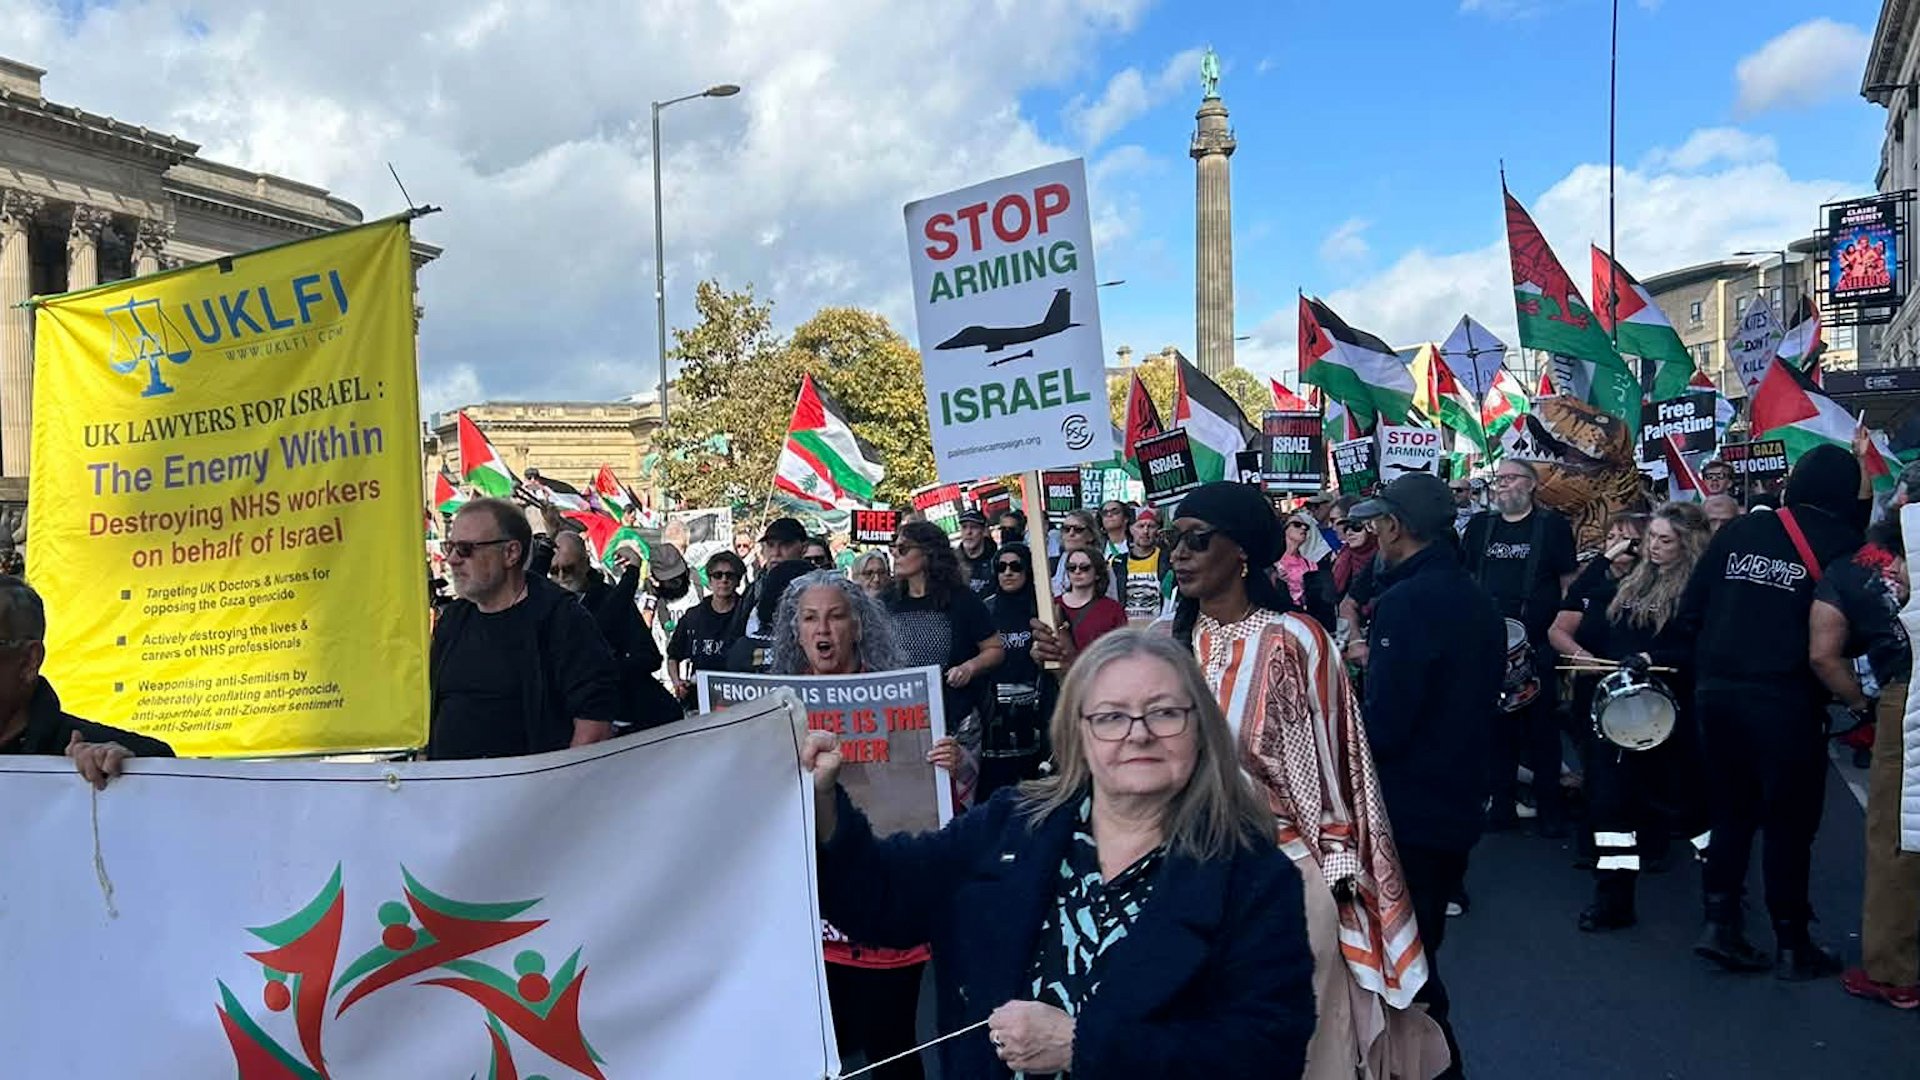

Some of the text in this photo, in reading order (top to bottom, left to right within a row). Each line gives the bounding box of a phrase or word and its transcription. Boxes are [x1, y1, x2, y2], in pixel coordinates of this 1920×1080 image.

[924, 183, 1071, 261] STOP
[929, 240, 1078, 304] ARMING
[183, 269, 349, 345] UKLFI
[939, 367, 1091, 426] ISRAEL
[84, 423, 120, 448] UK
[126, 406, 236, 444] LAWYERS
[241, 399, 285, 428] FOR
[290, 376, 370, 416] ISRAEL
[1657, 401, 1695, 421] Free
[1388, 431, 1437, 446] STOP
[1643, 415, 1714, 441] Palestine
[947, 435, 1041, 459] palestinecampaign.org
[1272, 436, 1312, 454] ISRAEL
[1386, 446, 1435, 458] ARMING
[1752, 442, 1784, 456] GAZA
[87, 421, 383, 496] The Enemy Within
[1148, 452, 1186, 475] ISRAEL
[1731, 455, 1786, 474] ENOCIDE
[89, 477, 382, 536] Destroying NHS workers
[856, 511, 896, 531] FREE
[132, 517, 344, 568] on behalf of Israel
[146, 586, 198, 601] Targeting
[200, 583, 216, 594] UK
[219, 577, 261, 591] Doctors
[263, 575, 272, 587] &
[312, 568, 331, 580] for
[143, 588, 296, 616] opposing the Gaza genocide
[142, 618, 309, 646] Actively destroying the lives &
[184, 645, 198, 658] of
[200, 643, 225, 656] NHS
[228, 637, 301, 657] professionals
[138, 669, 308, 692] Weaponising anti-Semitism by
[136, 692, 202, 707] deliberately
[206, 689, 261, 704] conflating
[288, 697, 344, 712] sentiment
[713, 683, 778, 701] “ENOU
[802, 687, 821, 703] IS
[851, 708, 878, 734] IS
[883, 702, 931, 733] THE
